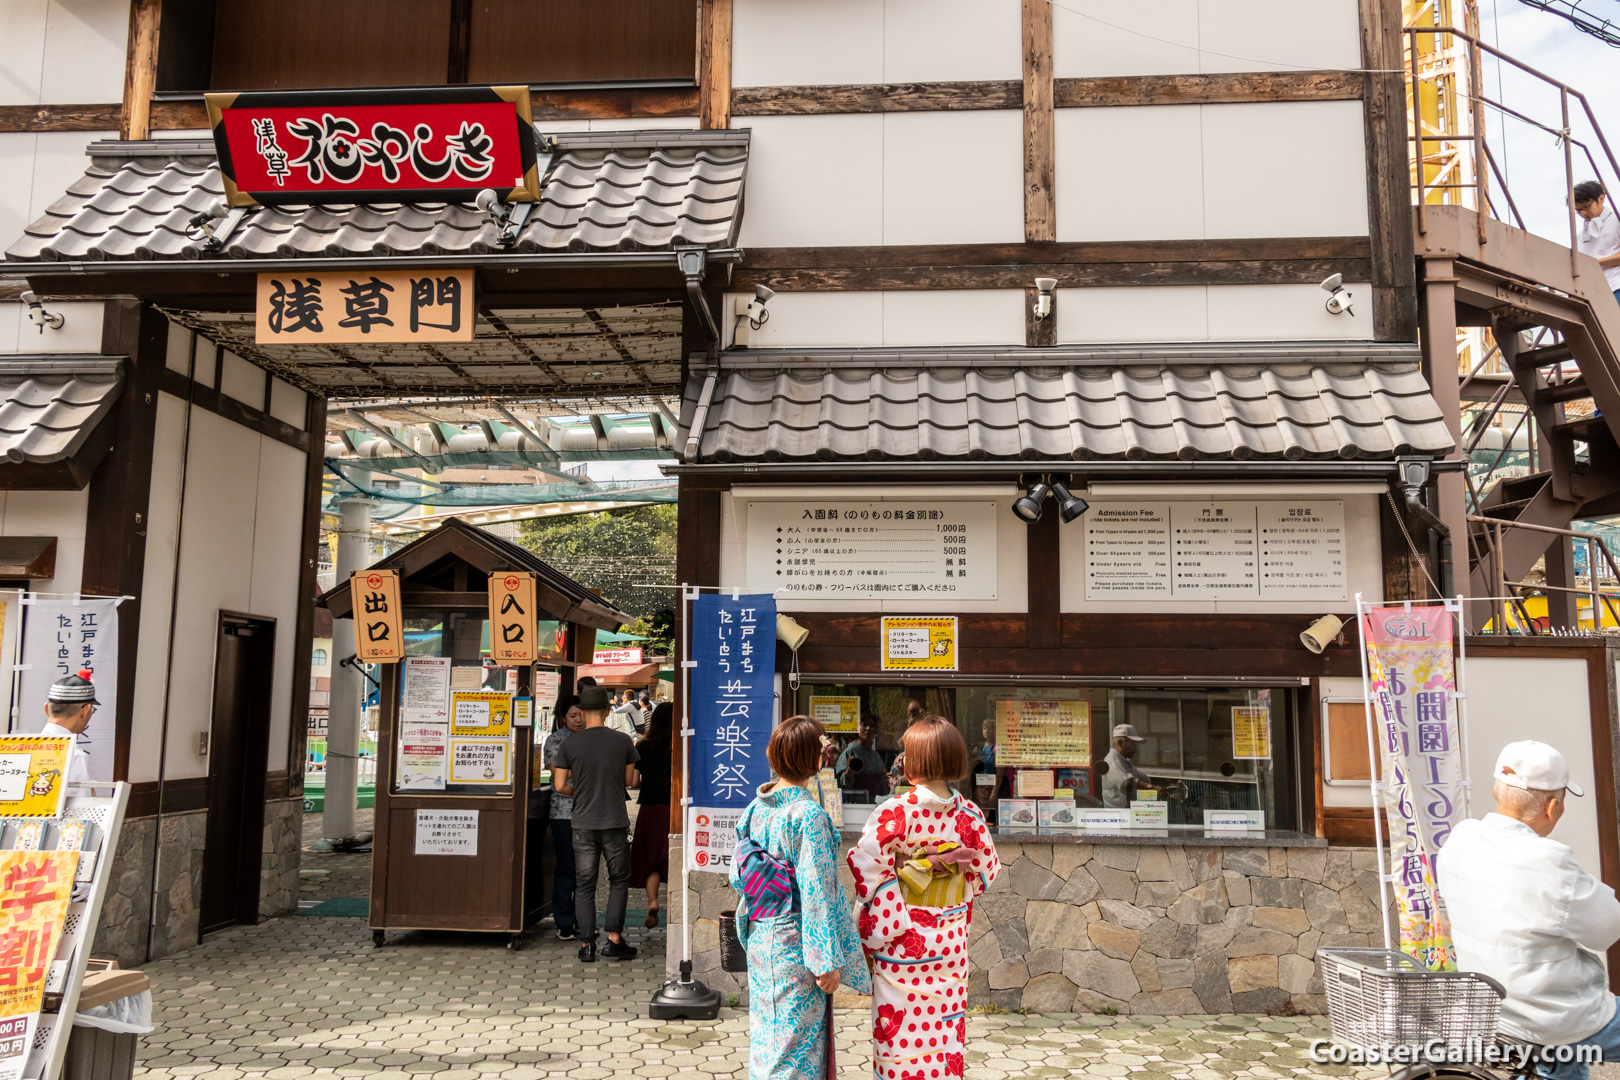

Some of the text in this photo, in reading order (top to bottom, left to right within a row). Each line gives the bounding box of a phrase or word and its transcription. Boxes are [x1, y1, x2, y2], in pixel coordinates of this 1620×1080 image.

[252, 118, 291, 186] 浅草
[287, 114, 495, 184] 花やしき
[268, 275, 462, 334] 浅草門
[802, 509, 838, 520] 入園料
[936, 524, 966, 533] 1,000円
[1289, 508, 1311, 516] 입장료
[943, 535, 966, 544] 500円
[943, 547, 966, 555] 500円
[364, 592, 390, 642] 出口
[500, 593, 525, 643] 入口
[718, 609, 734, 673] たいとう
[740, 608, 757, 673] 江戸まち
[57, 614, 72, 674] たいとう
[455, 752, 495, 760] をお連れの方は
[455, 759, 494, 767] お知らせ下さい
[711, 679, 752, 800] 芸楽祭
[0, 858, 57, 987] 学割
